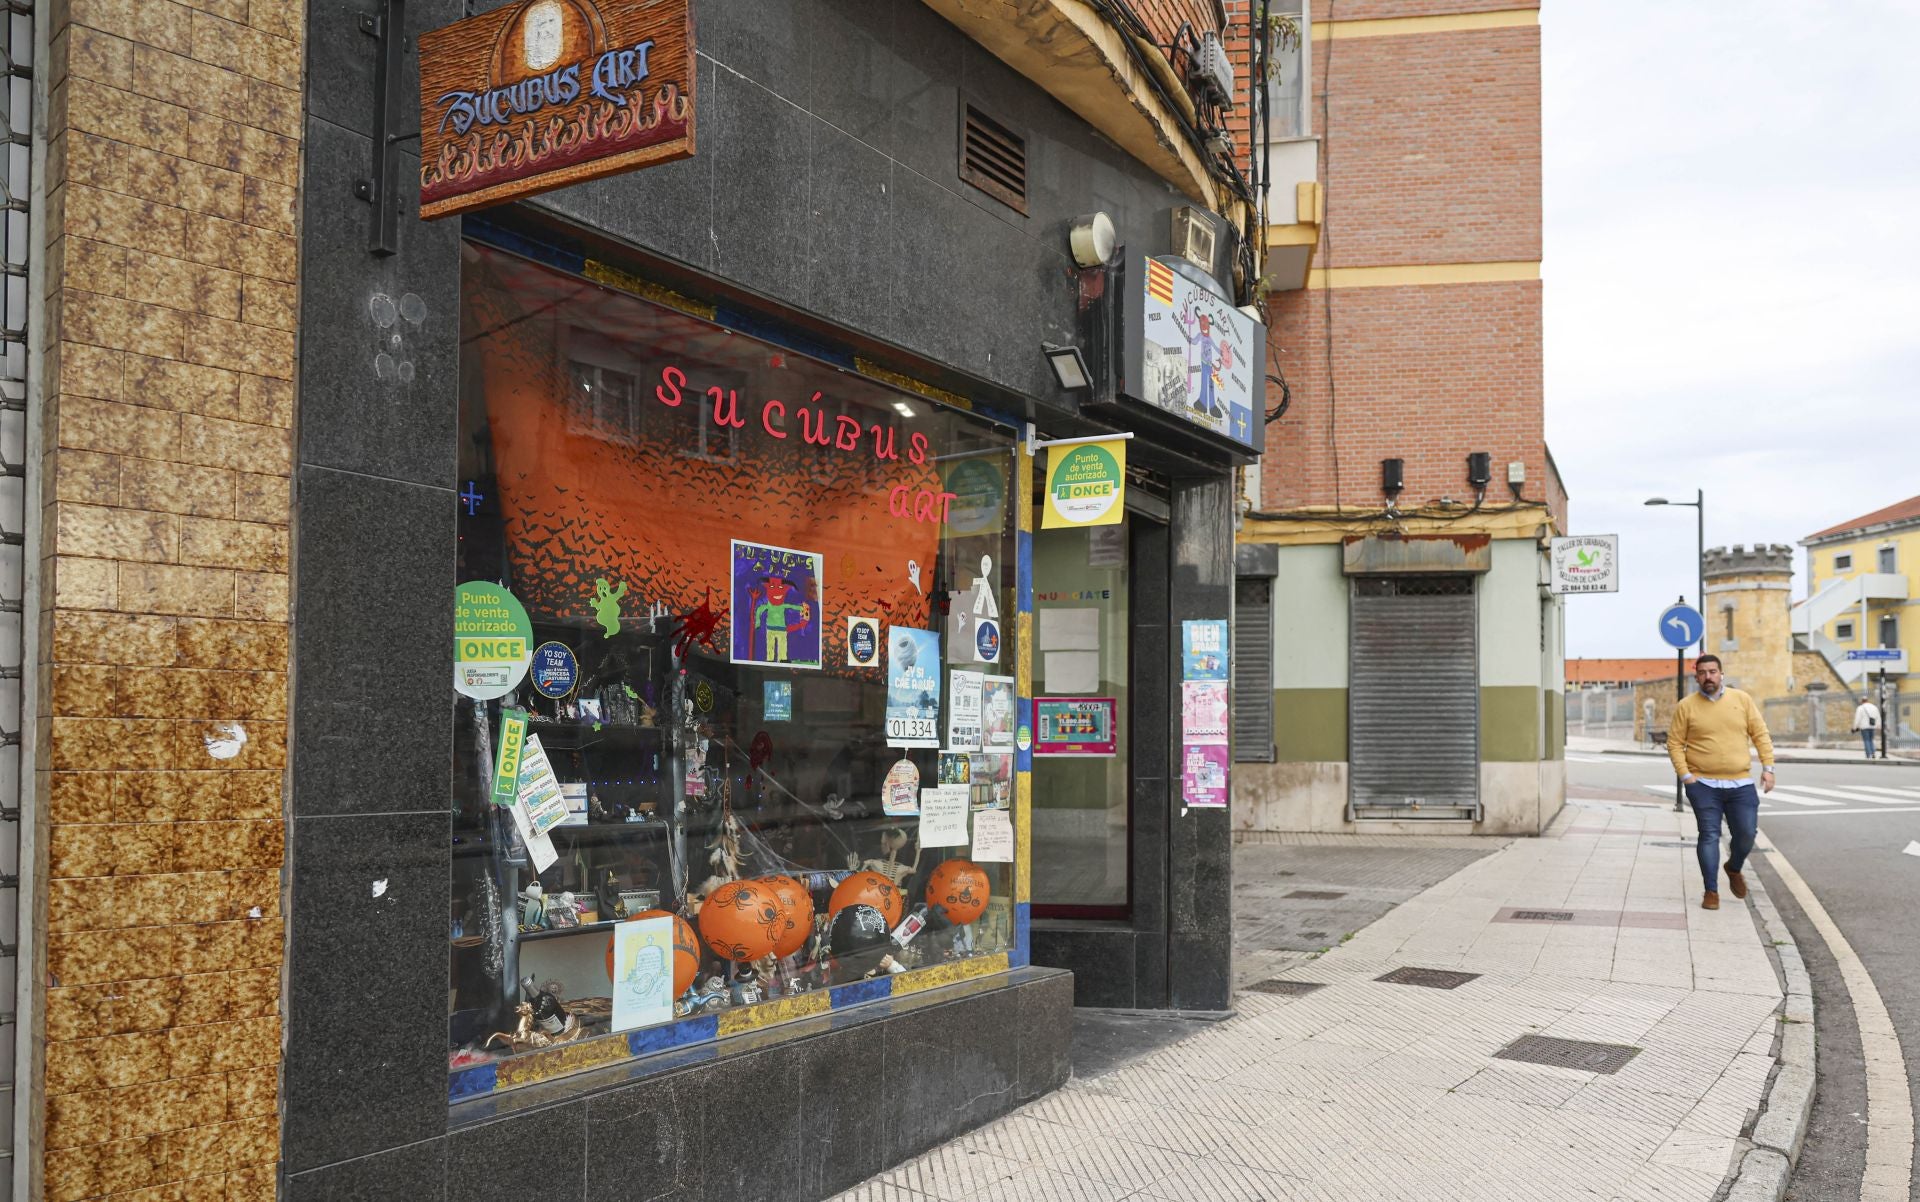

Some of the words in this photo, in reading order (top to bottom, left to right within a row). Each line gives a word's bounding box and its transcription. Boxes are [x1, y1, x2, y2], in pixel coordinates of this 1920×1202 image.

[590, 41, 655, 106] ART
[1075, 454, 1099, 463] Punto
[1070, 464, 1079, 472] de
[1082, 462, 1104, 471] venta
[1065, 471, 1107, 481] autorizado
[1073, 484, 1110, 496] ONCE
[462, 592, 500, 605] Punto
[474, 608, 509, 618] venta
[455, 619, 517, 632] utorizado
[465, 642, 521, 658] ONCE
[544, 649, 553, 658] YO
[553, 651, 567, 659] SOY
[546, 657, 564, 666] TEAM
[502, 723, 520, 773] ONCE
